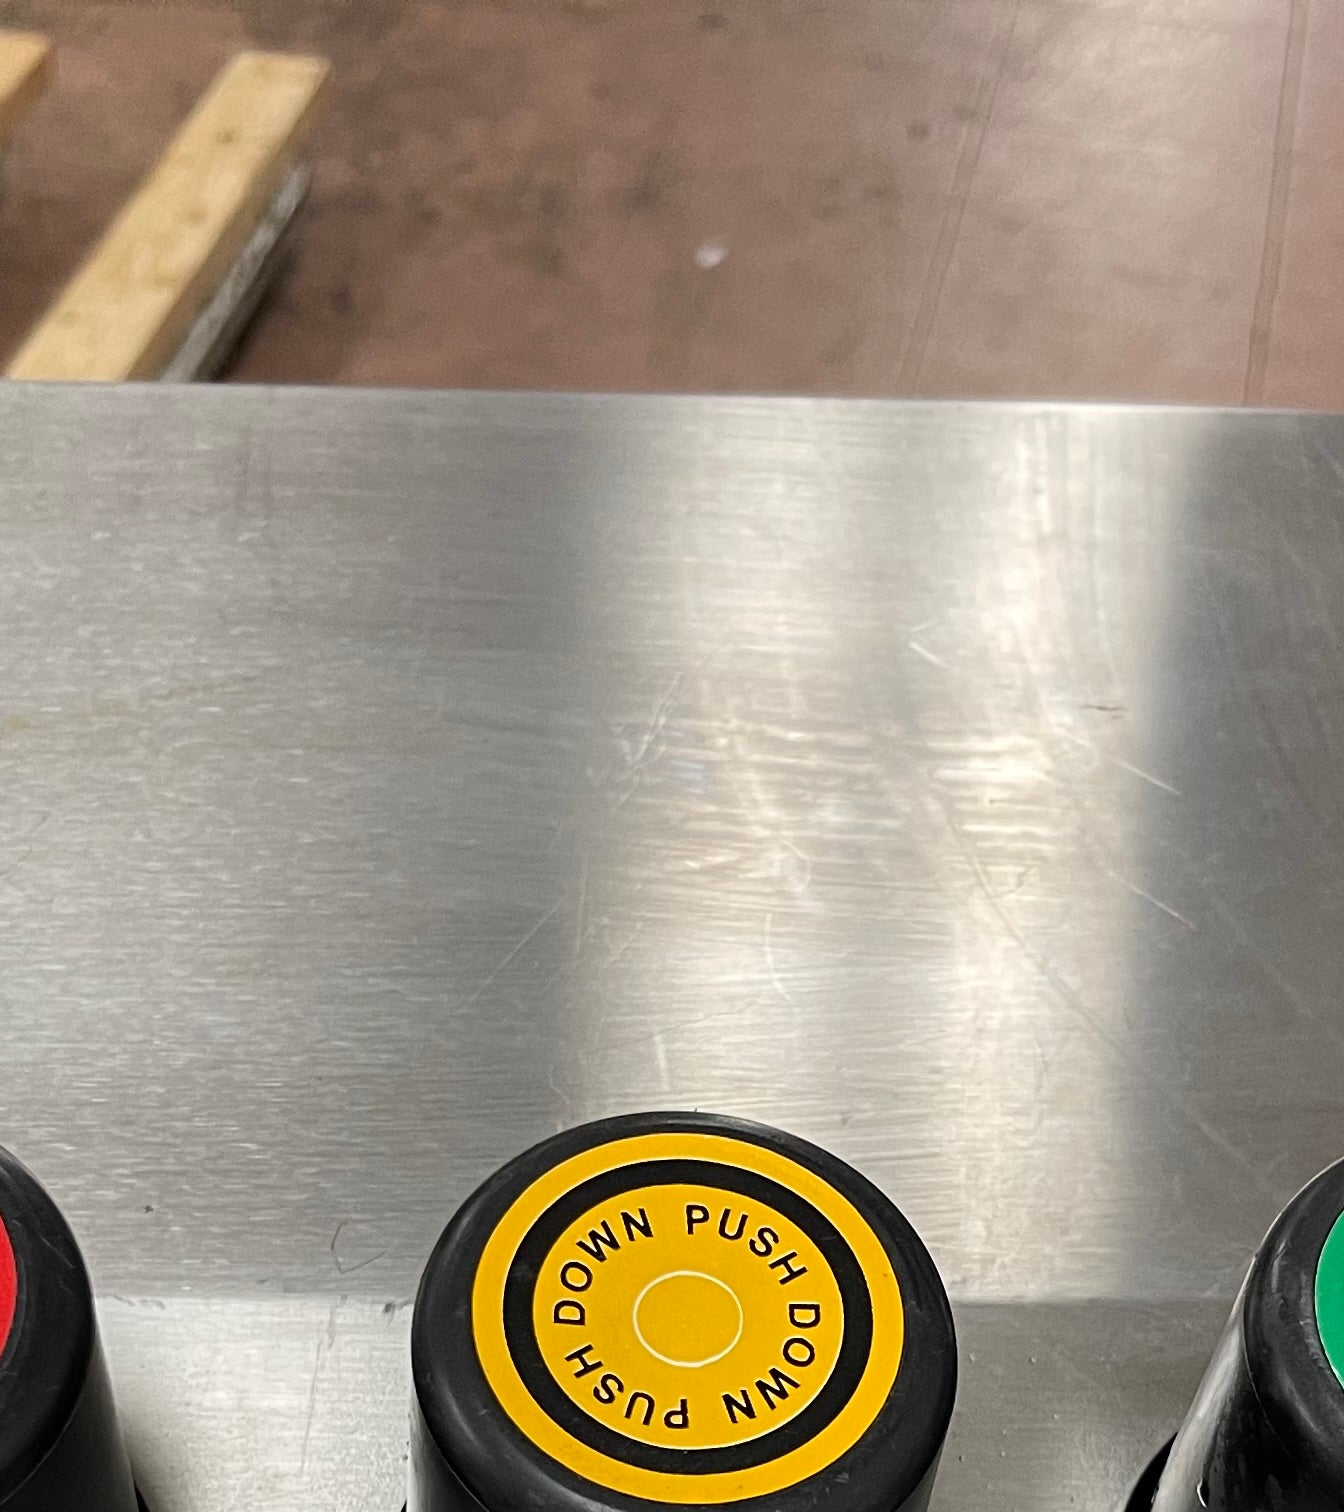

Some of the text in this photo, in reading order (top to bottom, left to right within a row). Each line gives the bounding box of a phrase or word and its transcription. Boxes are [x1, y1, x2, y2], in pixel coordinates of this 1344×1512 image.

[553, 1204, 821, 1430] PUSH DOWN PUSH DOWN
